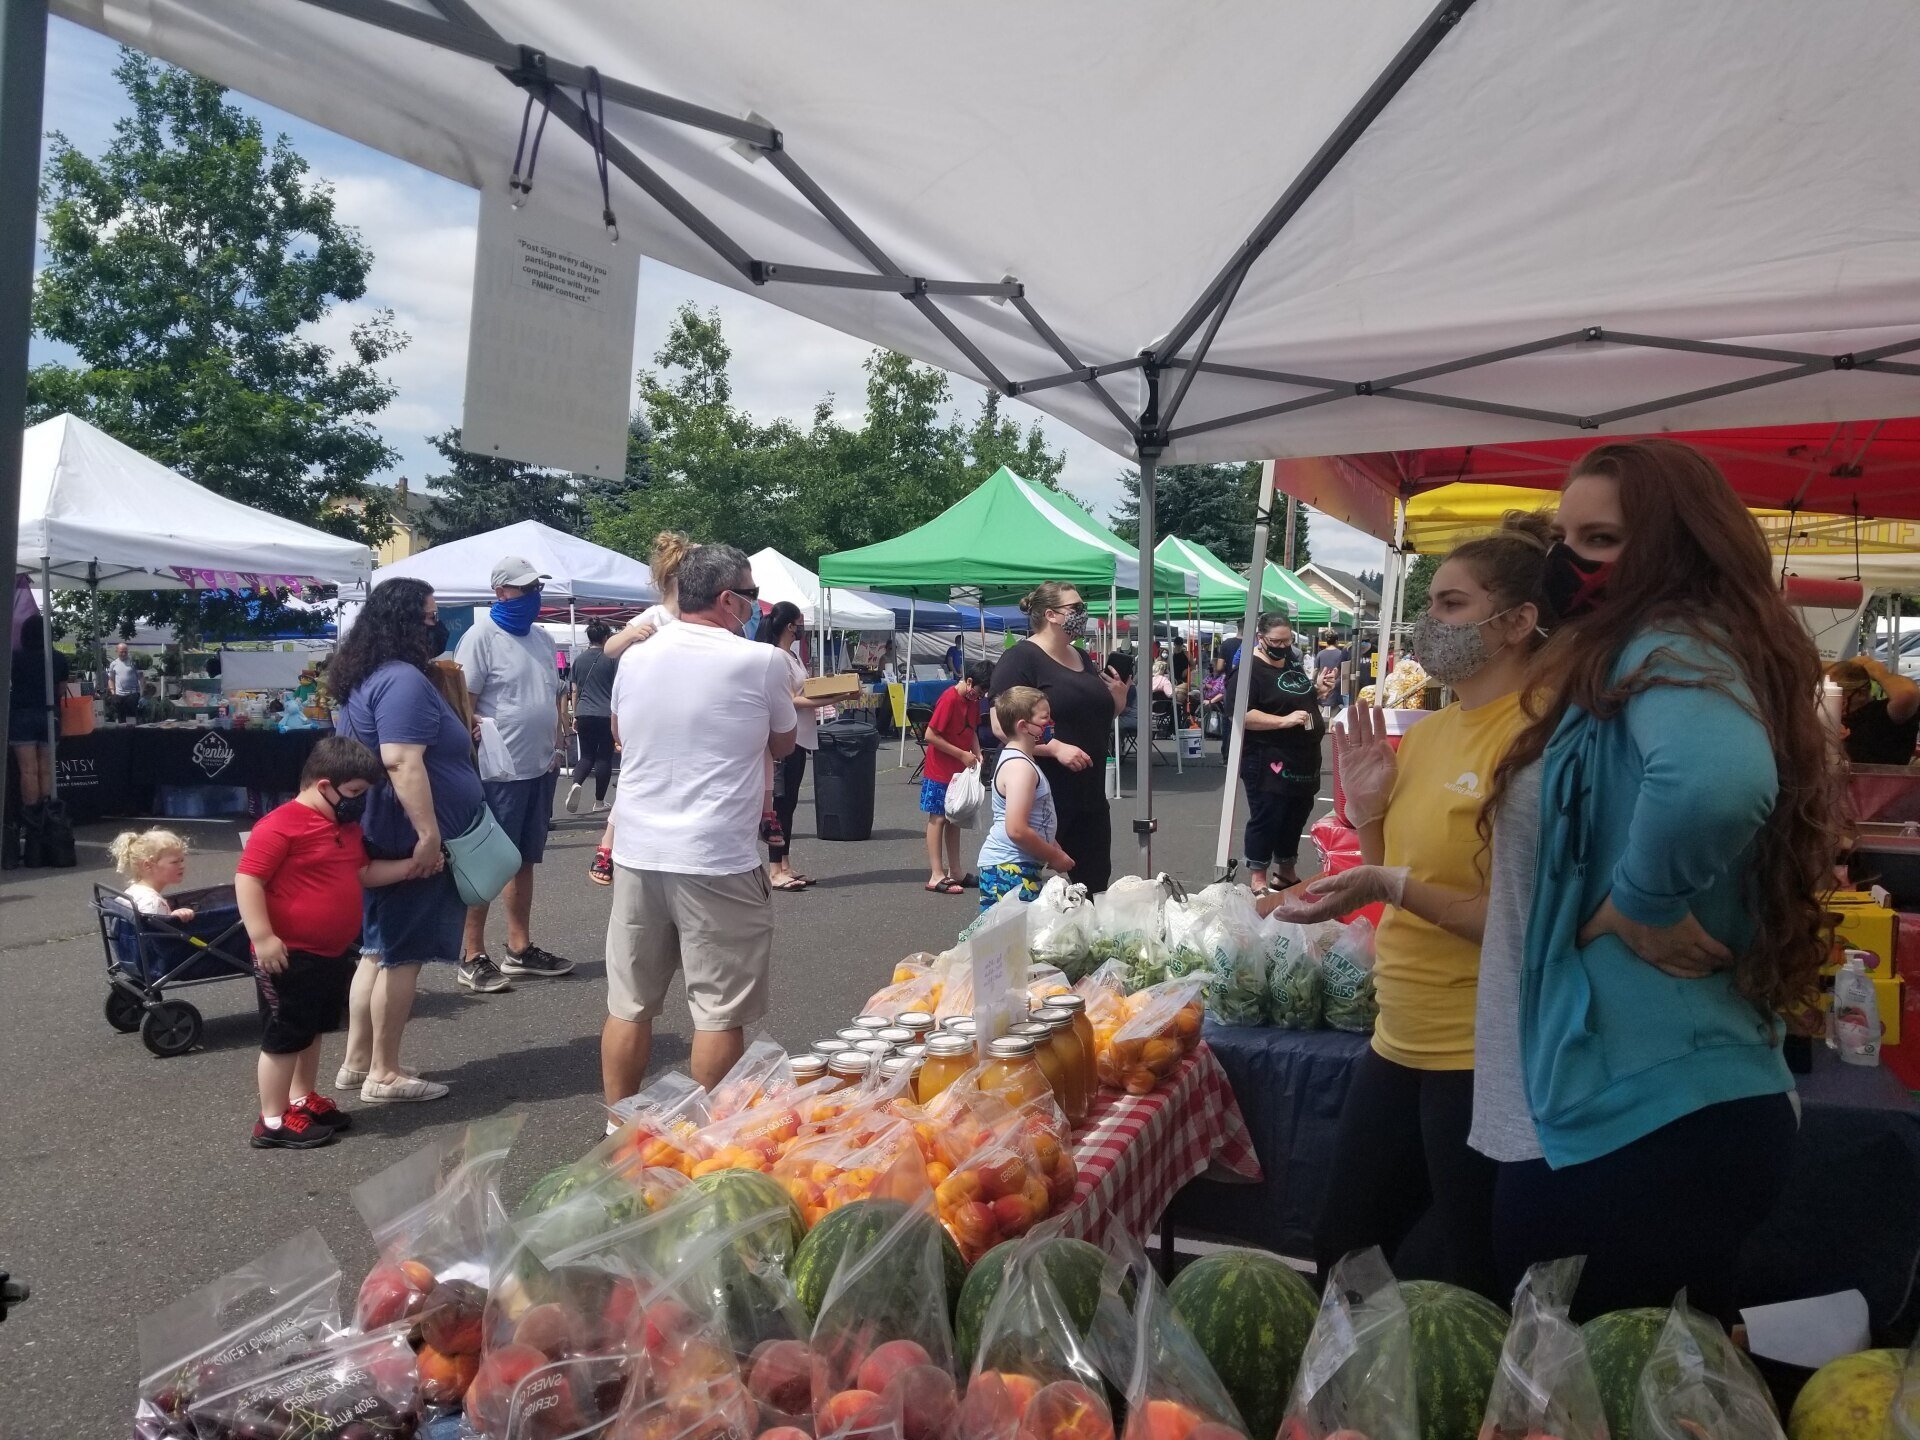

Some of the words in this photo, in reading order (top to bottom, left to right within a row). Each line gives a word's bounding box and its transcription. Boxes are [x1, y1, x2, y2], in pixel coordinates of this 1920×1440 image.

[525, 255, 566, 273] participate
[568, 268, 575, 276] to
[577, 270, 591, 282] stay
[592, 275, 599, 283] in
[540, 246, 557, 258] Sign
[559, 253, 579, 266] every
[580, 259, 593, 271] day
[594, 266, 607, 276] you
[522, 265, 566, 284] compliance
[567, 279, 583, 290] with
[584, 285, 600, 295] your
[531, 279, 555, 291] FMNP
[213, 1342, 251, 1366] SWEET
[249, 1317, 299, 1350] CHERRIES
[268, 1377, 303, 1398] SWEET
[282, 1387, 328, 1413] CERISES
[326, 1370, 368, 1395] DOUCES
[324, 1409, 355, 1433] PLU#
[353, 1396, 379, 1417] 4045
